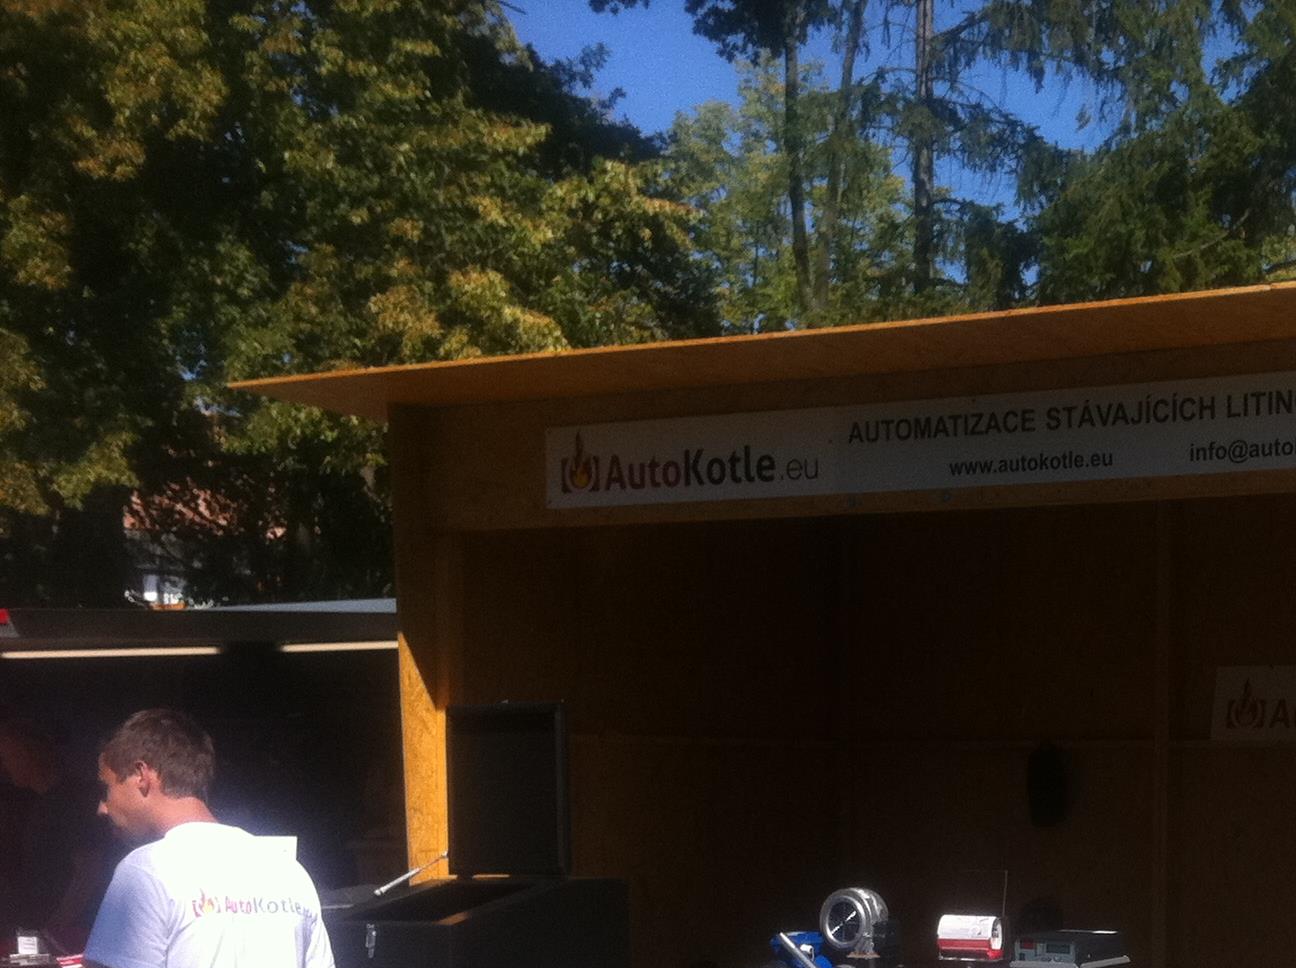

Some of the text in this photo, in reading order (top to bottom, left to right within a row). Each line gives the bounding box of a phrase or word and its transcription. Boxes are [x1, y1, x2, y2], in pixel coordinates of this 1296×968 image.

[849, 408, 1036, 444] AUTOMATIZACE
[1046, 393, 1215, 432] STÁVAJÍCÍCH
[949, 450, 1113, 477] www.autokotle.eu
